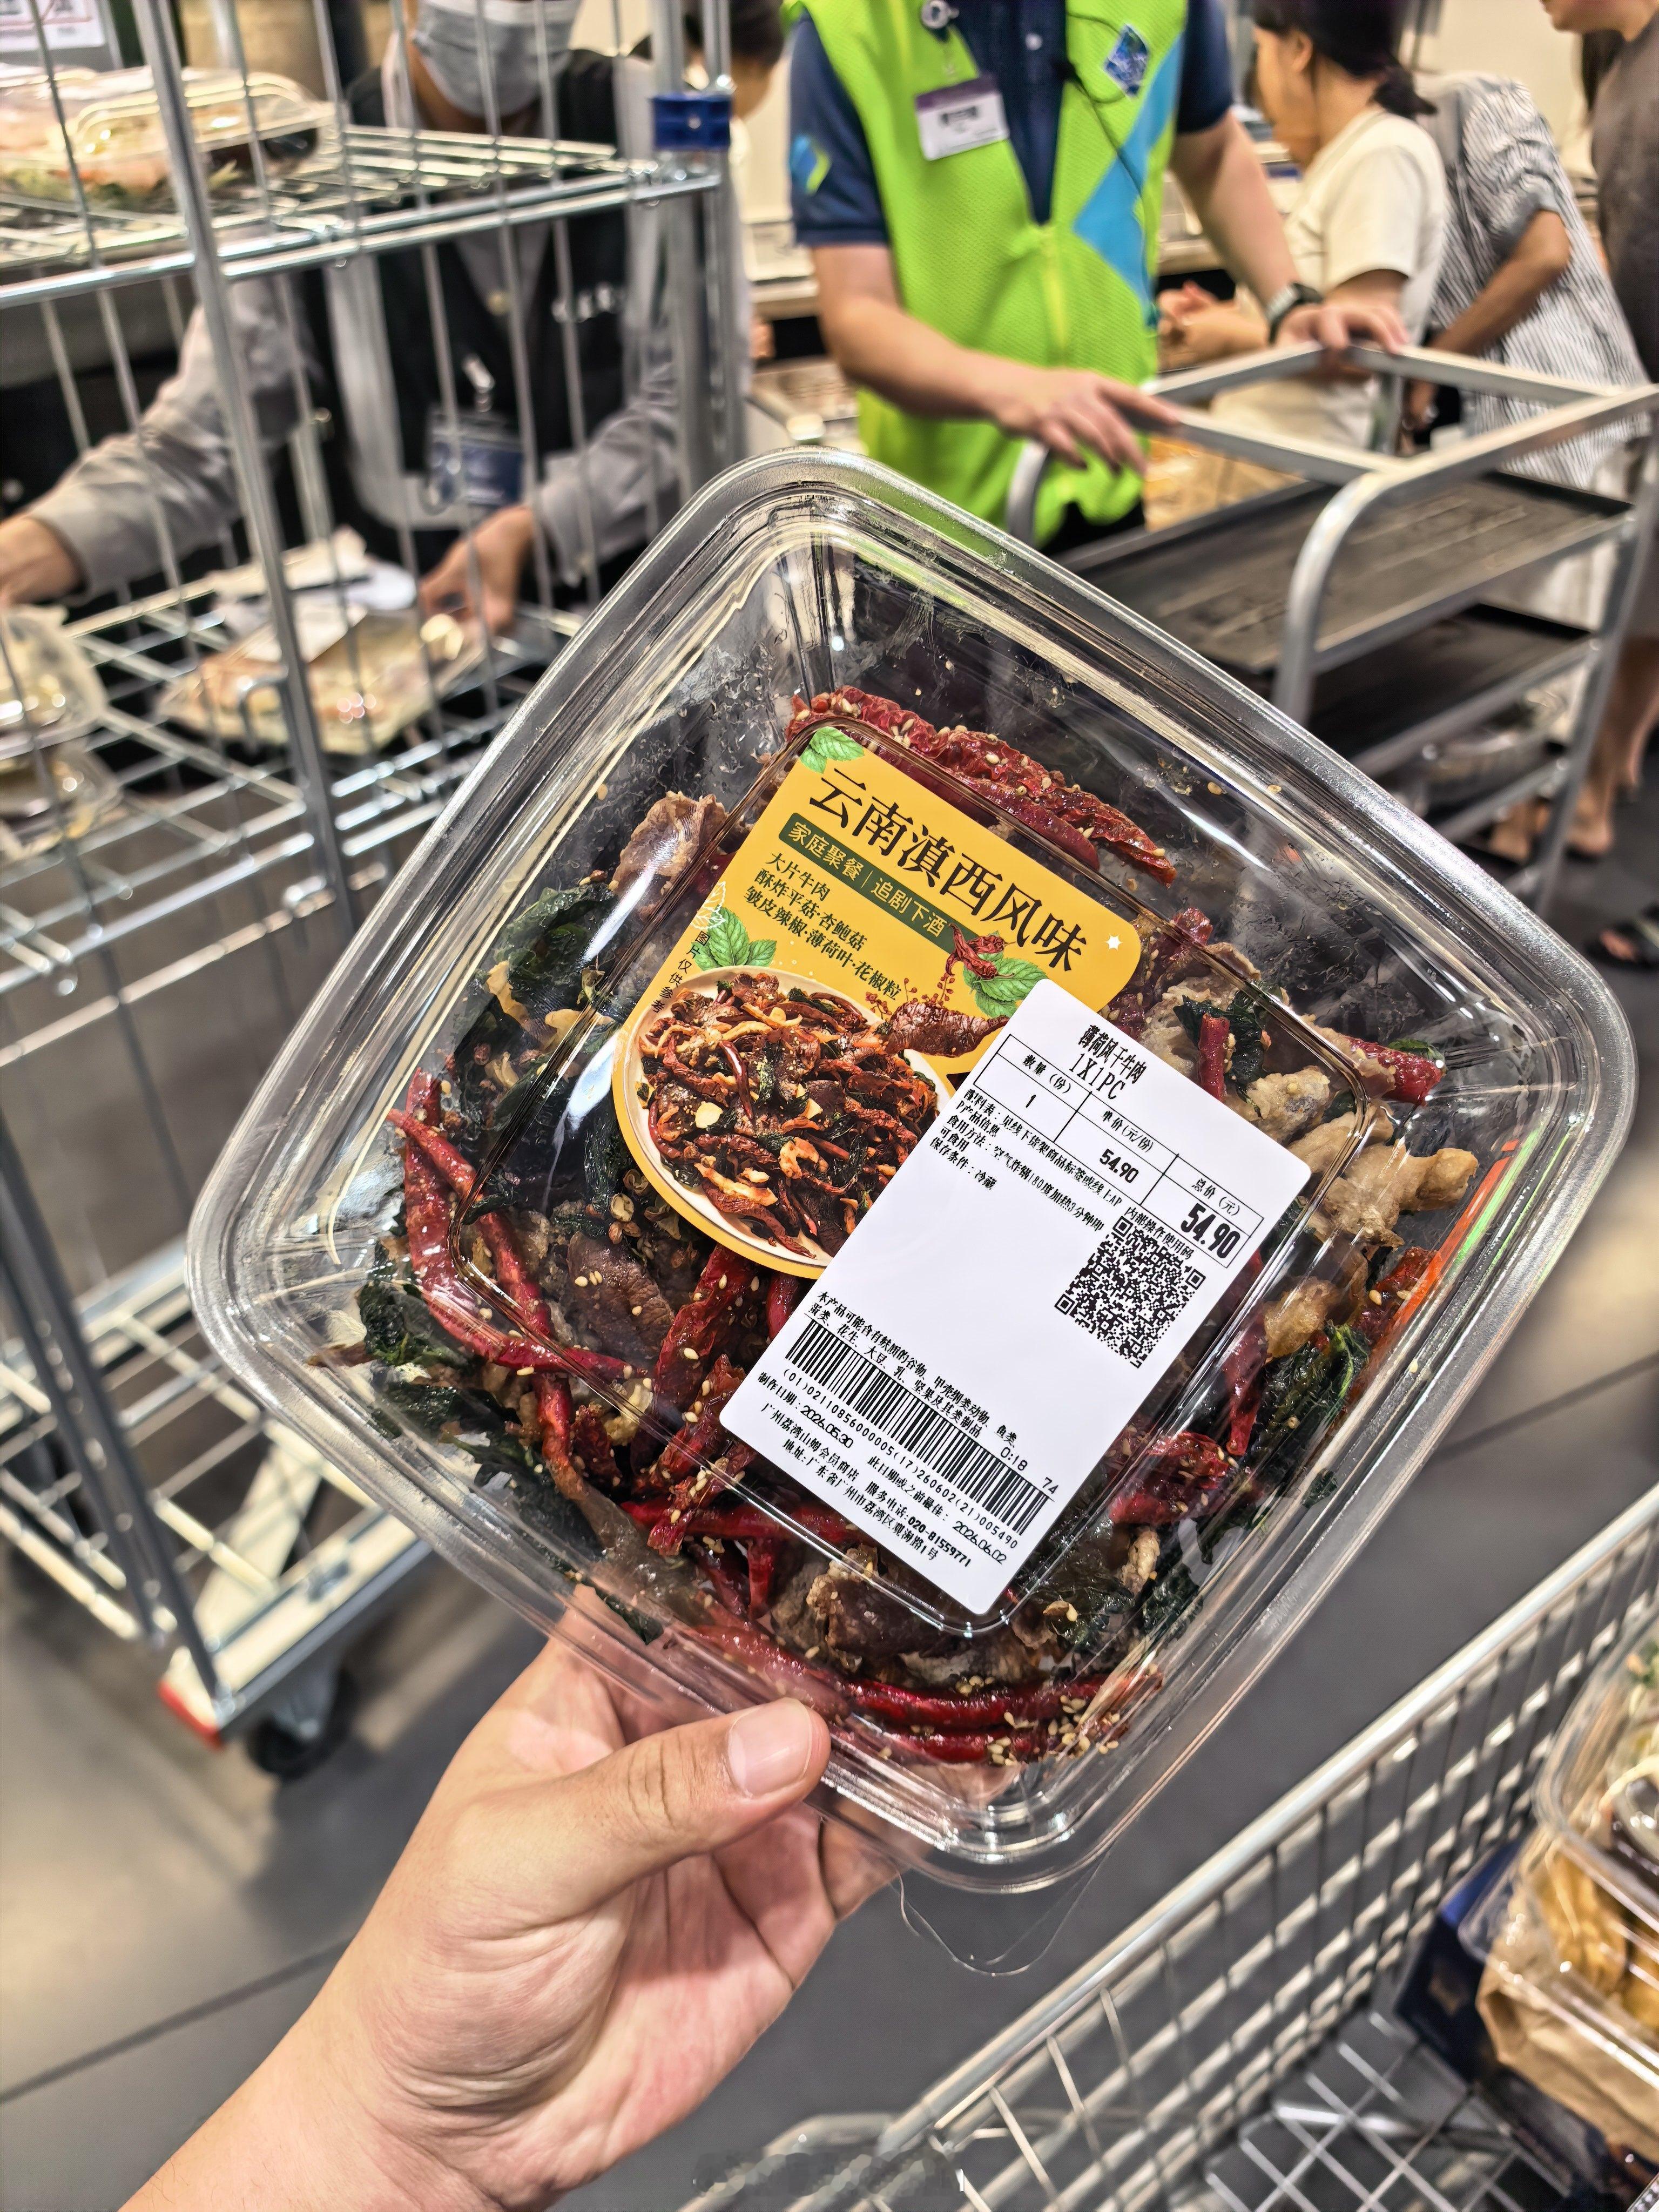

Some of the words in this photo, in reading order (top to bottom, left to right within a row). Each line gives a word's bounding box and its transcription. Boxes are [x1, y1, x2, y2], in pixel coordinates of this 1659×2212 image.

[766, 852, 831, 901] 大片牛肉
[784, 817, 867, 885] 家庭聚餐
[867, 874, 949, 939] 追剧下酒
[808, 767, 1087, 972] 云南滇西风味
[754, 868, 867, 952] 酥炸平菇·杏鲍菇
[744, 885, 902, 1001] 皱皮辣椒·薄荷叶·花椒粒
[649, 930, 711, 1015] 图片仅供参考
[1068, 1053, 1126, 1100] 1X1PC
[1077, 1024, 1147, 1084] 薄荷风干牛肉
[955, 1100, 1000, 1137] P产品信息
[1024, 1094, 1036, 1108] 1
[940, 1125, 970, 1152] 可食用
[1098, 1148, 1139, 1183] 54.90
[1123, 1206, 1195, 1260] 内部操作使用码
[1180, 1202, 1240, 1259] 54.90
[760, 1402, 860, 1482] 广州荔湾山姆会员商店
[1042, 1476, 1058, 1494] 74
[952, 1520, 1007, 1564] 2026.06.02
